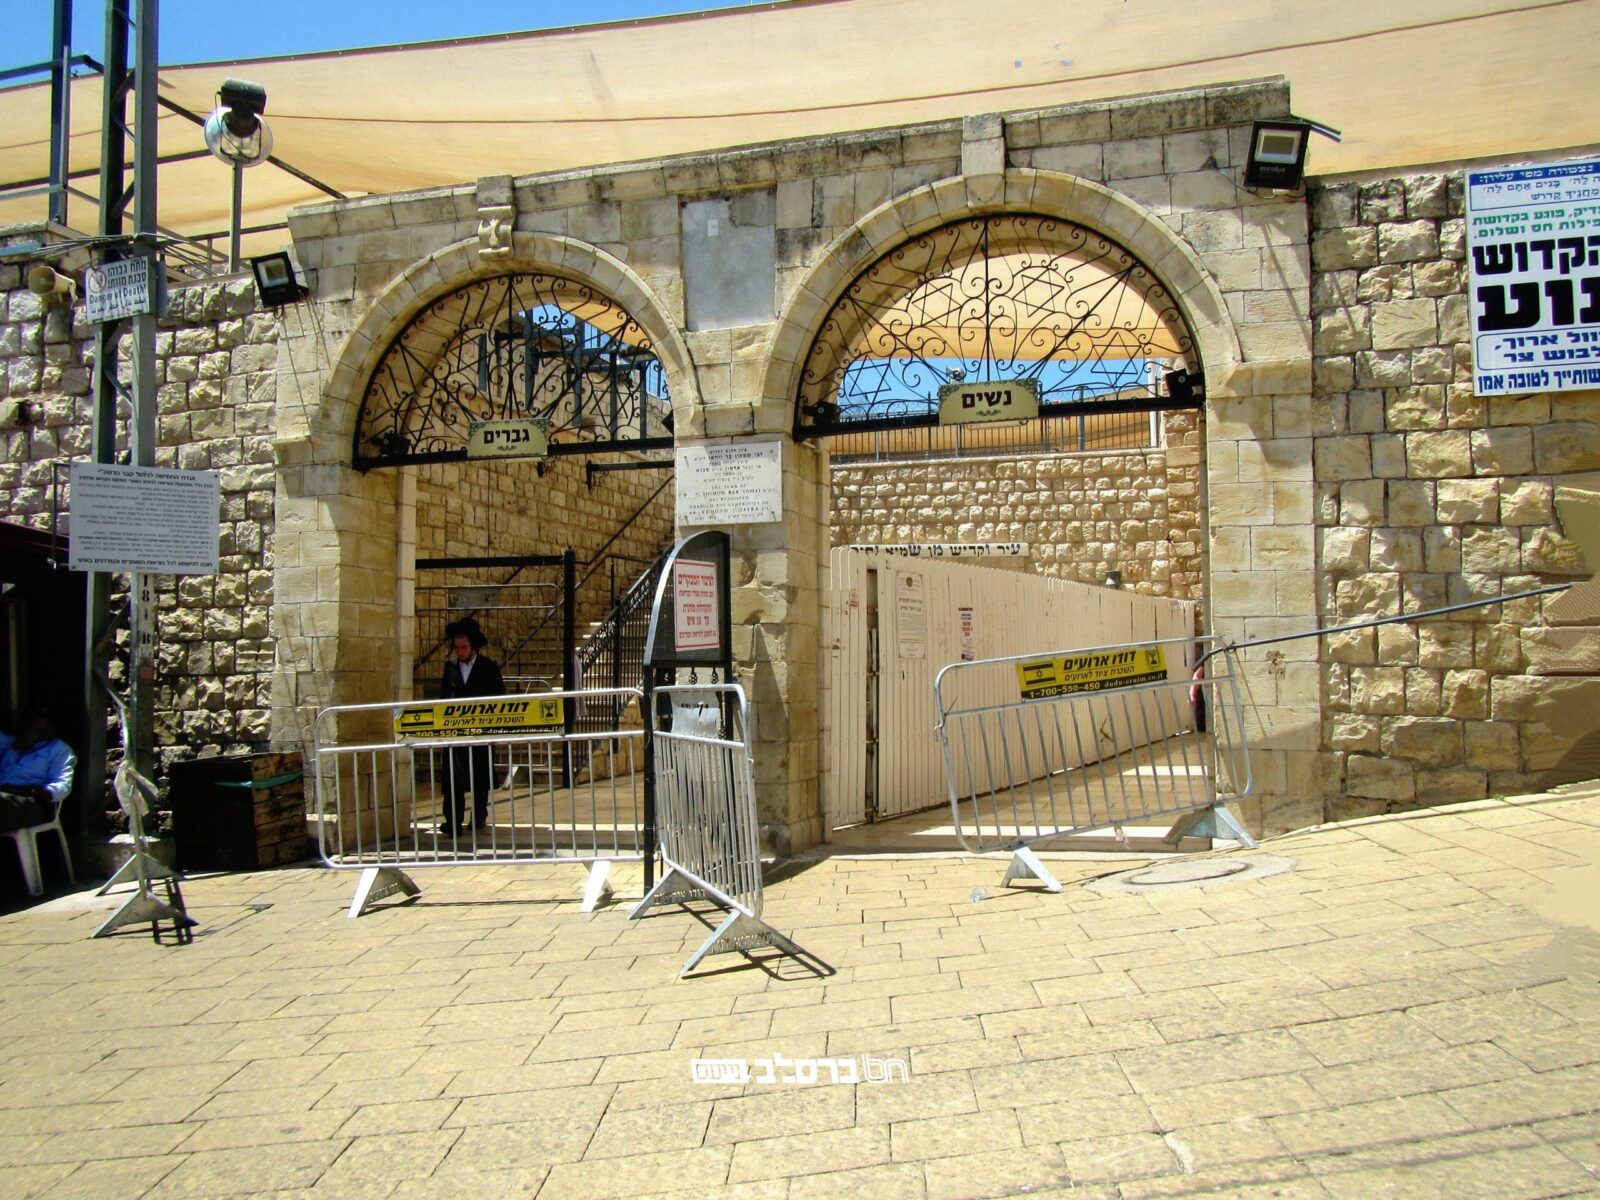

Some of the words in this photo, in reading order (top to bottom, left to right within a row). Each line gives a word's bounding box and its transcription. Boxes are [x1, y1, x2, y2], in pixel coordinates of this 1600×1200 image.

[1534, 208, 1564, 220] פוגע
[1569, 206, 1600, 218] דיק,
[1472, 213, 1528, 225] בקדושת
[1474, 225, 1525, 239] ושלום.
[1532, 223, 1552, 232] חס
[130, 260, 146, 272] מתח
[90, 294, 112, 304] Danger
[115, 290, 121, 299] of
[1567, 331, 1600, 344] וול
[1504, 352, 1534, 363] צר
[1543, 346, 1600, 361] לבוש
[1478, 375, 1503, 393] אמן
[1508, 370, 1549, 389] לטובה
[962, 390, 1012, 408] נשים
[484, 429, 530, 444] גברים
[927, 545, 943, 558] מן
[950, 544, 990, 558] וקדיש
[997, 544, 1021, 555] עיר
[1064, 655, 1110, 670] ארועים
[1112, 650, 1136, 664] דודו
[1110, 666, 1134, 675] השכרת
[1030, 682, 1100, 698] 1-700-550-450
[444, 703, 497, 716] ארועים
[500, 702, 529, 713] דודו
[444, 716, 475, 727] לארועים
[495, 716, 524, 724] השכרת
